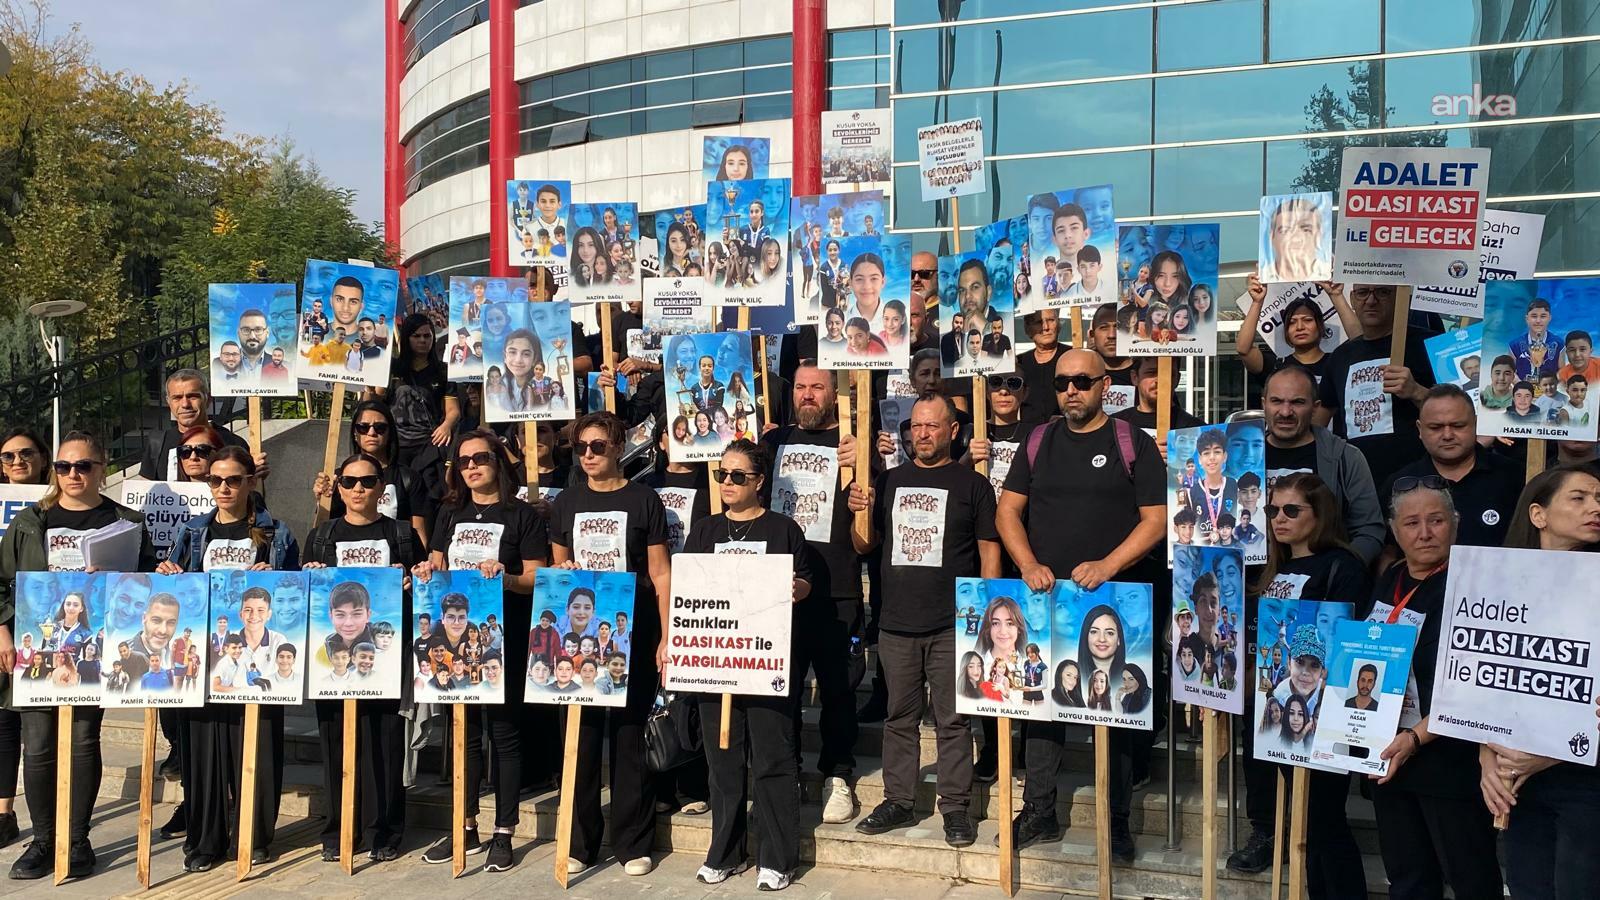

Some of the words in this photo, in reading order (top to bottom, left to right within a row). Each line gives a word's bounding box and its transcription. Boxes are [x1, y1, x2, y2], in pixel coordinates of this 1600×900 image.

[1353, 161, 1479, 187] ADALET
[1348, 195, 1413, 213] OLASI
[1417, 196, 1476, 214] KAST
[1346, 228, 1368, 242] İLE
[1374, 225, 1473, 245] GELECEK
[1479, 253, 1500, 267] çin
[1259, 285, 1298, 322] ampiyon
[318, 372, 338, 380] FAHRİ
[341, 375, 365, 383] ARKAR
[1537, 428, 1569, 436] BİLGEN
[126, 492, 175, 506] Birlikte
[674, 596, 731, 613] Deprem
[1456, 596, 1529, 624] Adalet
[673, 616, 739, 629] Sanıkları
[672, 635, 713, 648] OLASI
[715, 636, 754, 649] KAST
[755, 636, 773, 650] ile
[1452, 628, 1518, 656] OLASI
[1521, 635, 1590, 666] KAST
[671, 654, 785, 671] YARGILANMALI!
[1448, 655, 1472, 682] ile
[1477, 664, 1592, 702] GELECEK!
[56, 695, 101, 703] İPEKÇİOĞLU
[1000, 708, 1030, 716] KALAYCI
[1058, 712, 1083, 720] DUYGU
[1084, 714, 1113, 723] BOLSOY
[1114, 717, 1146, 727] KALAYCI
[1349, 714, 1367, 722] HASAN
[1267, 750, 1287, 760] SAHİL
